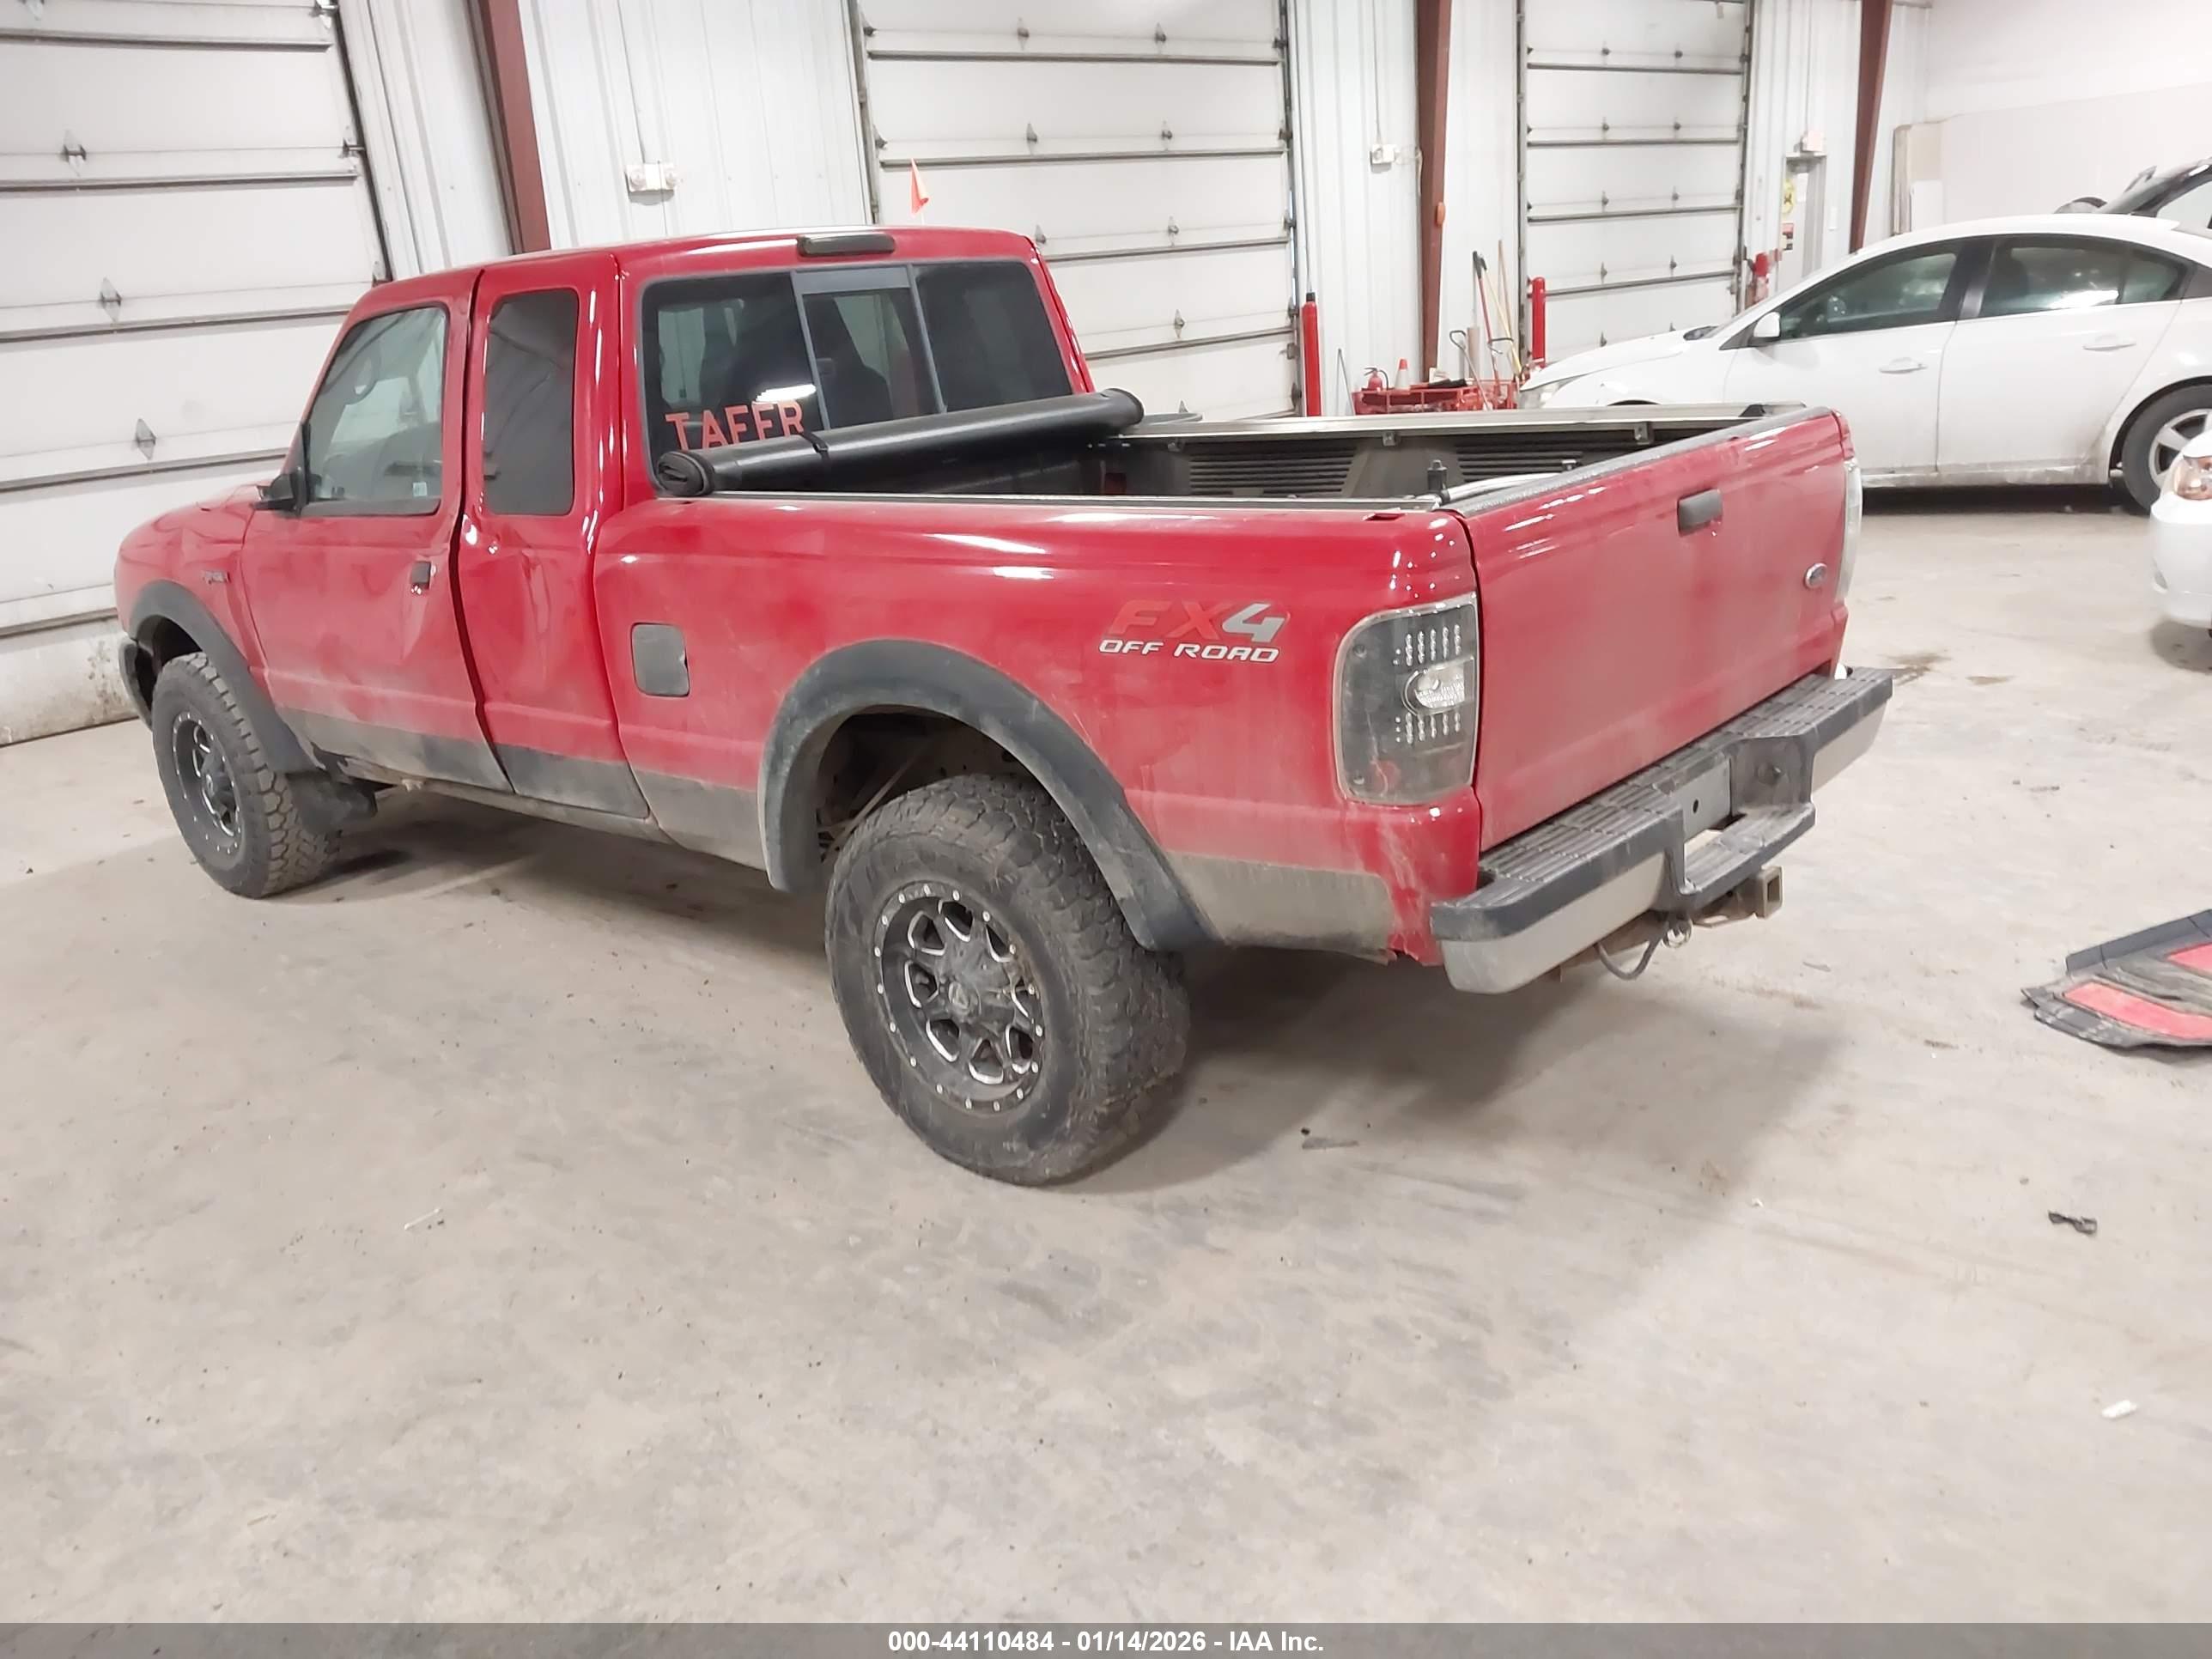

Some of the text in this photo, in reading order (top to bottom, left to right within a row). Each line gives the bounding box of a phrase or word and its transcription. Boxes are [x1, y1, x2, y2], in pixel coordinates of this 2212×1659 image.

[1109, 599, 1286, 642] FX4
[1098, 639, 1280, 662] OFF ROAD
